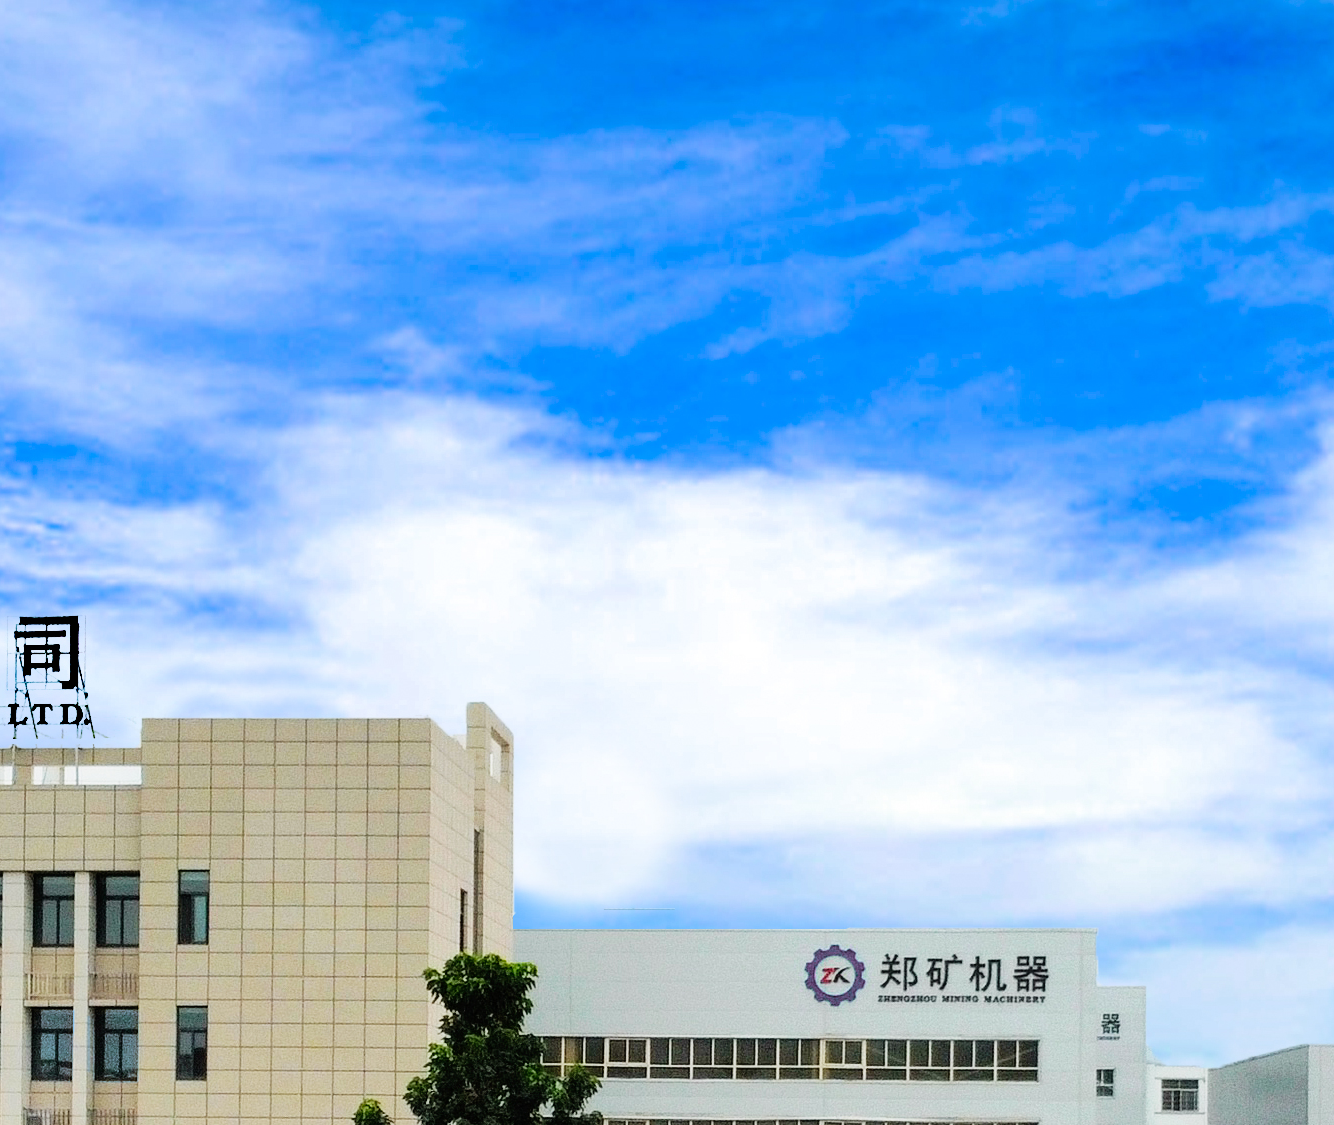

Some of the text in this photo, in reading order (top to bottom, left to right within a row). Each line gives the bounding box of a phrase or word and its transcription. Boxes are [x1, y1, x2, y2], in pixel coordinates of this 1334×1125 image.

[7, 702, 91, 727] LTD.
[820, 965, 852, 985] ZK
[881, 954, 1049, 992] 郑矿机器
[877, 995, 1046, 1004] ZHENGZHOU MINING MACHINERY
[1102, 1014, 1120, 1033] 器
